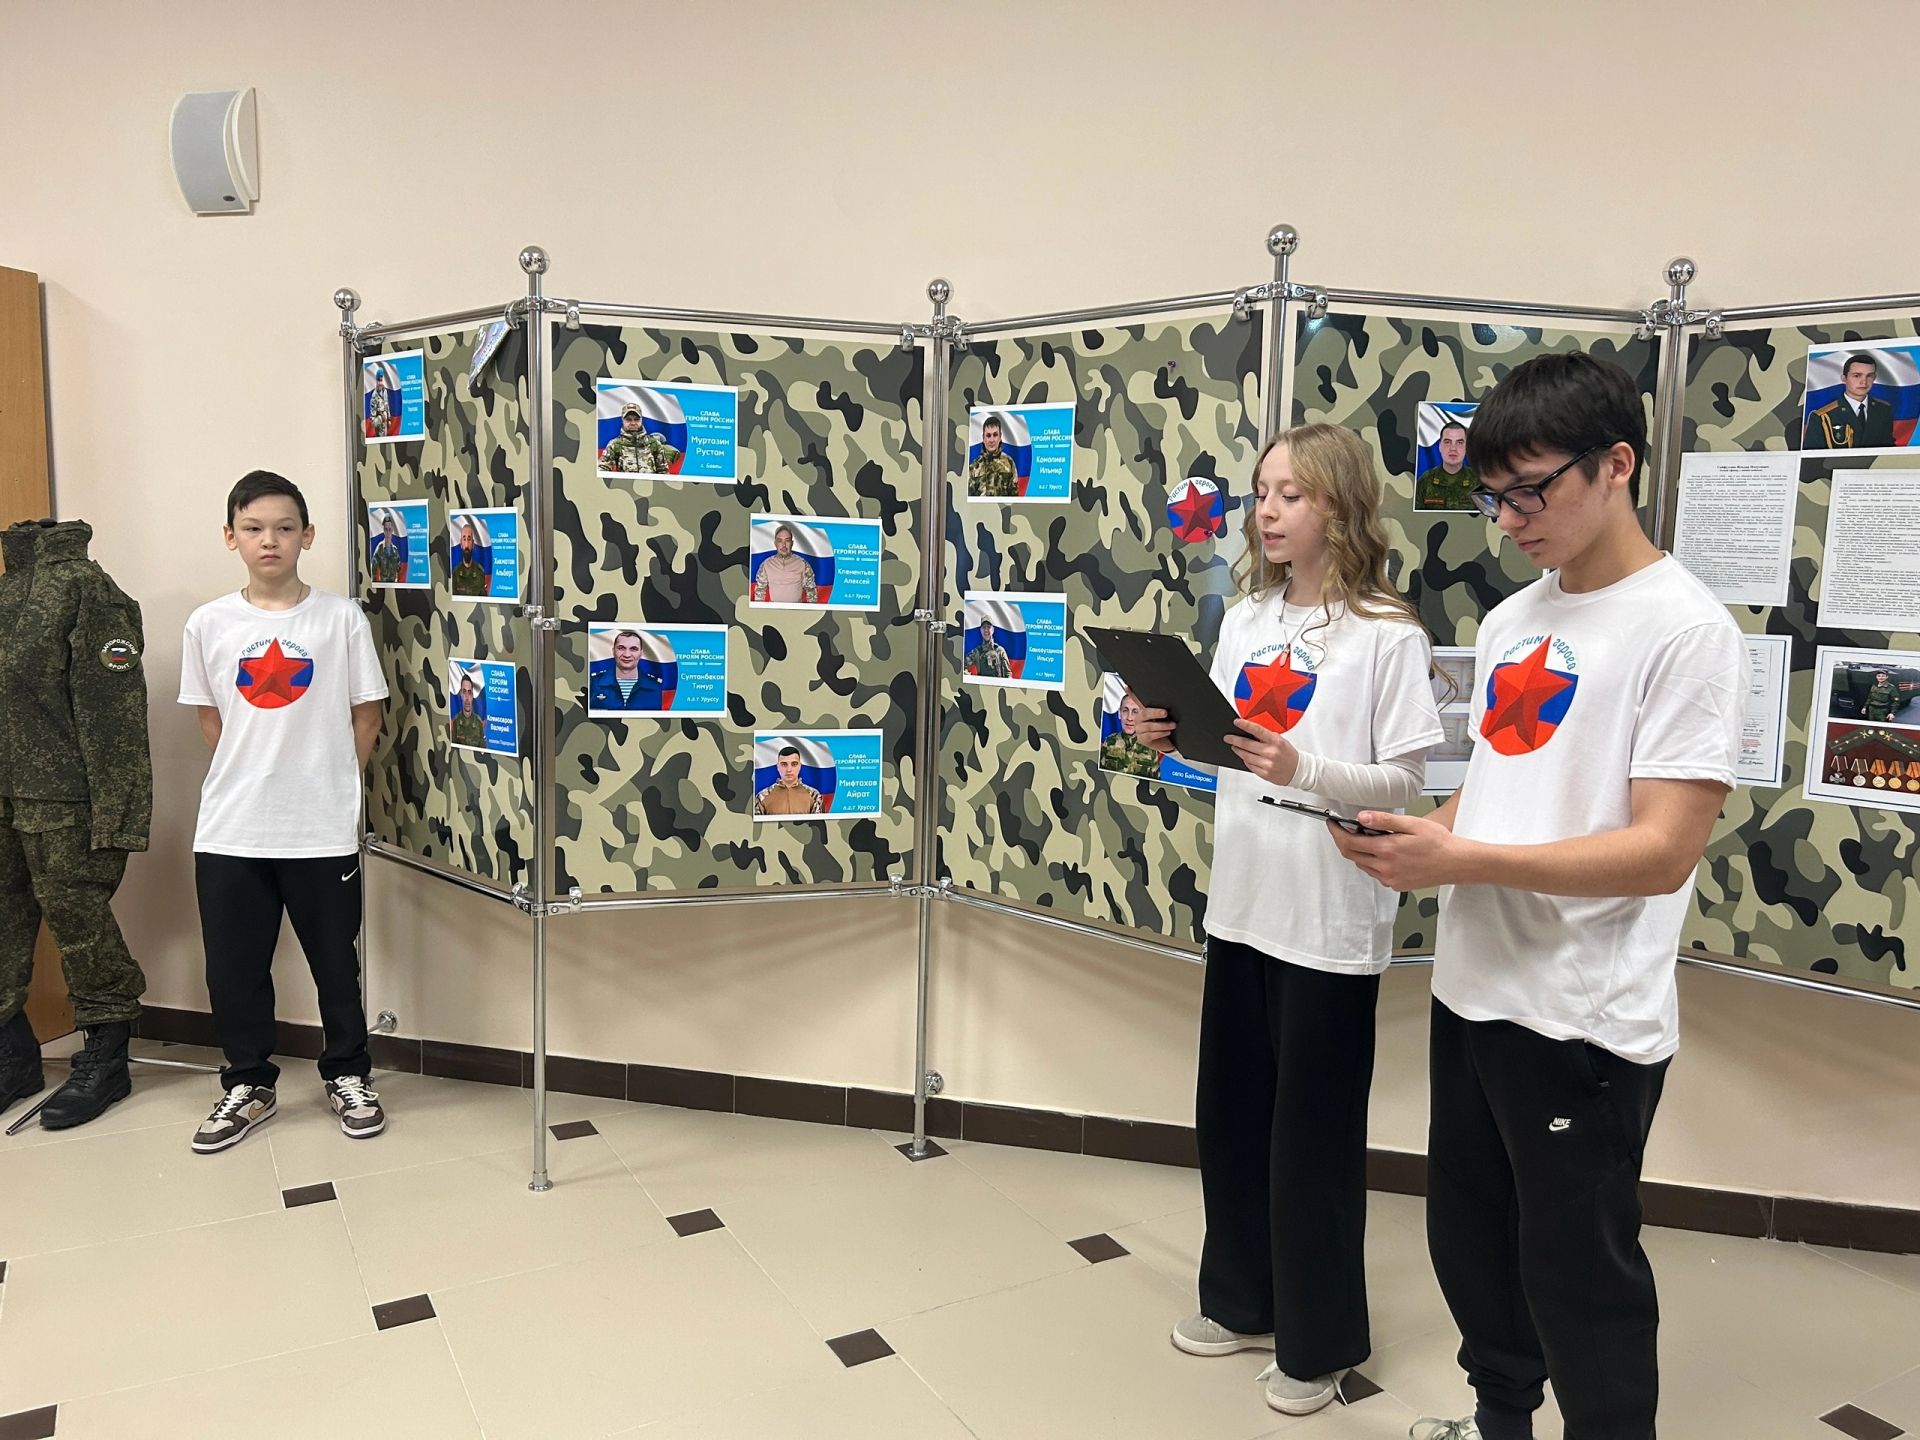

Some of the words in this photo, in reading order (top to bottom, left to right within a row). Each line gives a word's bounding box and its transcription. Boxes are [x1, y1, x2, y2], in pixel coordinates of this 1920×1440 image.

[691, 436, 730, 446] Муртазин
[696, 448, 724, 456] Рустам
[1169, 482, 1188, 502] Растим
[1196, 480, 1216, 490] героев
[102, 639, 138, 654] ЗАПОРОЖСКИЙ
[282, 639, 308, 657] героев
[1503, 635, 1544, 660] Растим
[1552, 638, 1576, 670] героев
[1250, 644, 1284, 661] Растим
[1293, 646, 1314, 671] героев
[488, 686, 509, 694] РОССИИ
[846, 790, 870, 798] Айрат
[1552, 1117, 1572, 1126] NIKE
